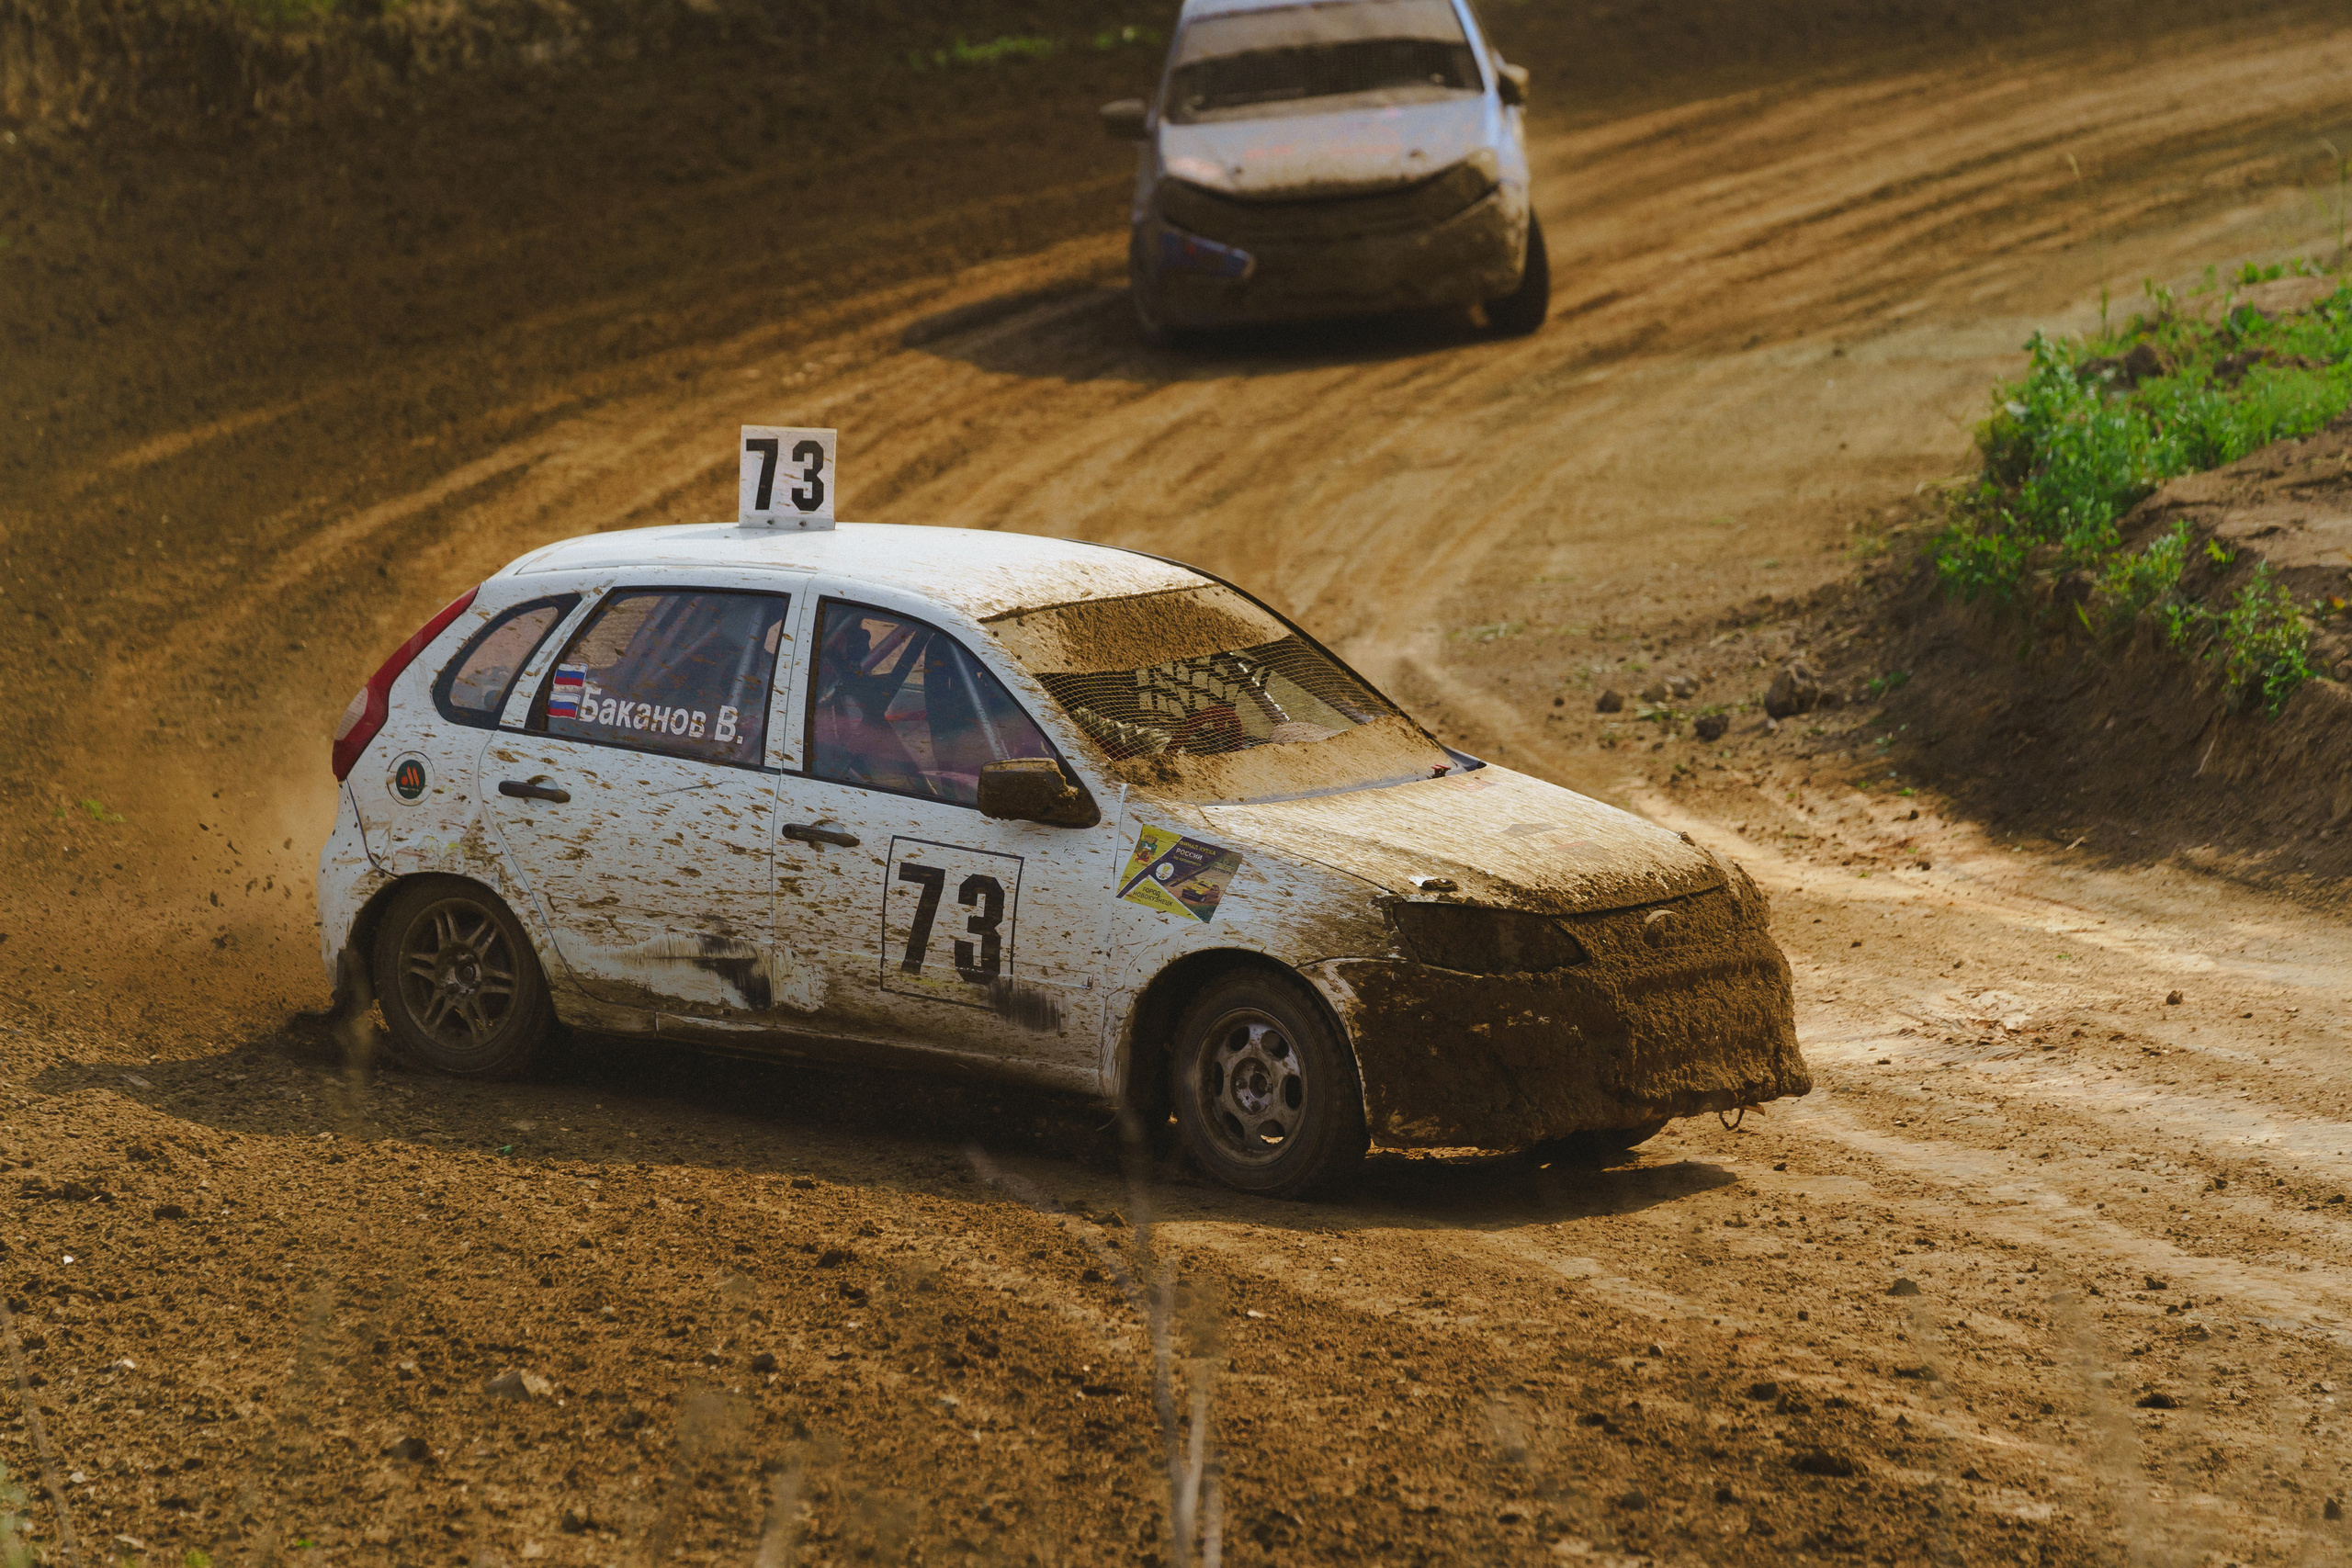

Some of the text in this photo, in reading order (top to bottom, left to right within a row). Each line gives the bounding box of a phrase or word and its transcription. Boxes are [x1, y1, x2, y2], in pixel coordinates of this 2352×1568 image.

[746, 438, 824, 512] 73
[579, 686, 743, 745] Баканов В.
[1176, 848, 1204, 861] РОССИИ
[1133, 891, 1173, 907] НОВОКУЗНЕЦК
[1142, 886, 1161, 897] ГОРОД
[899, 862, 1005, 986] 73
